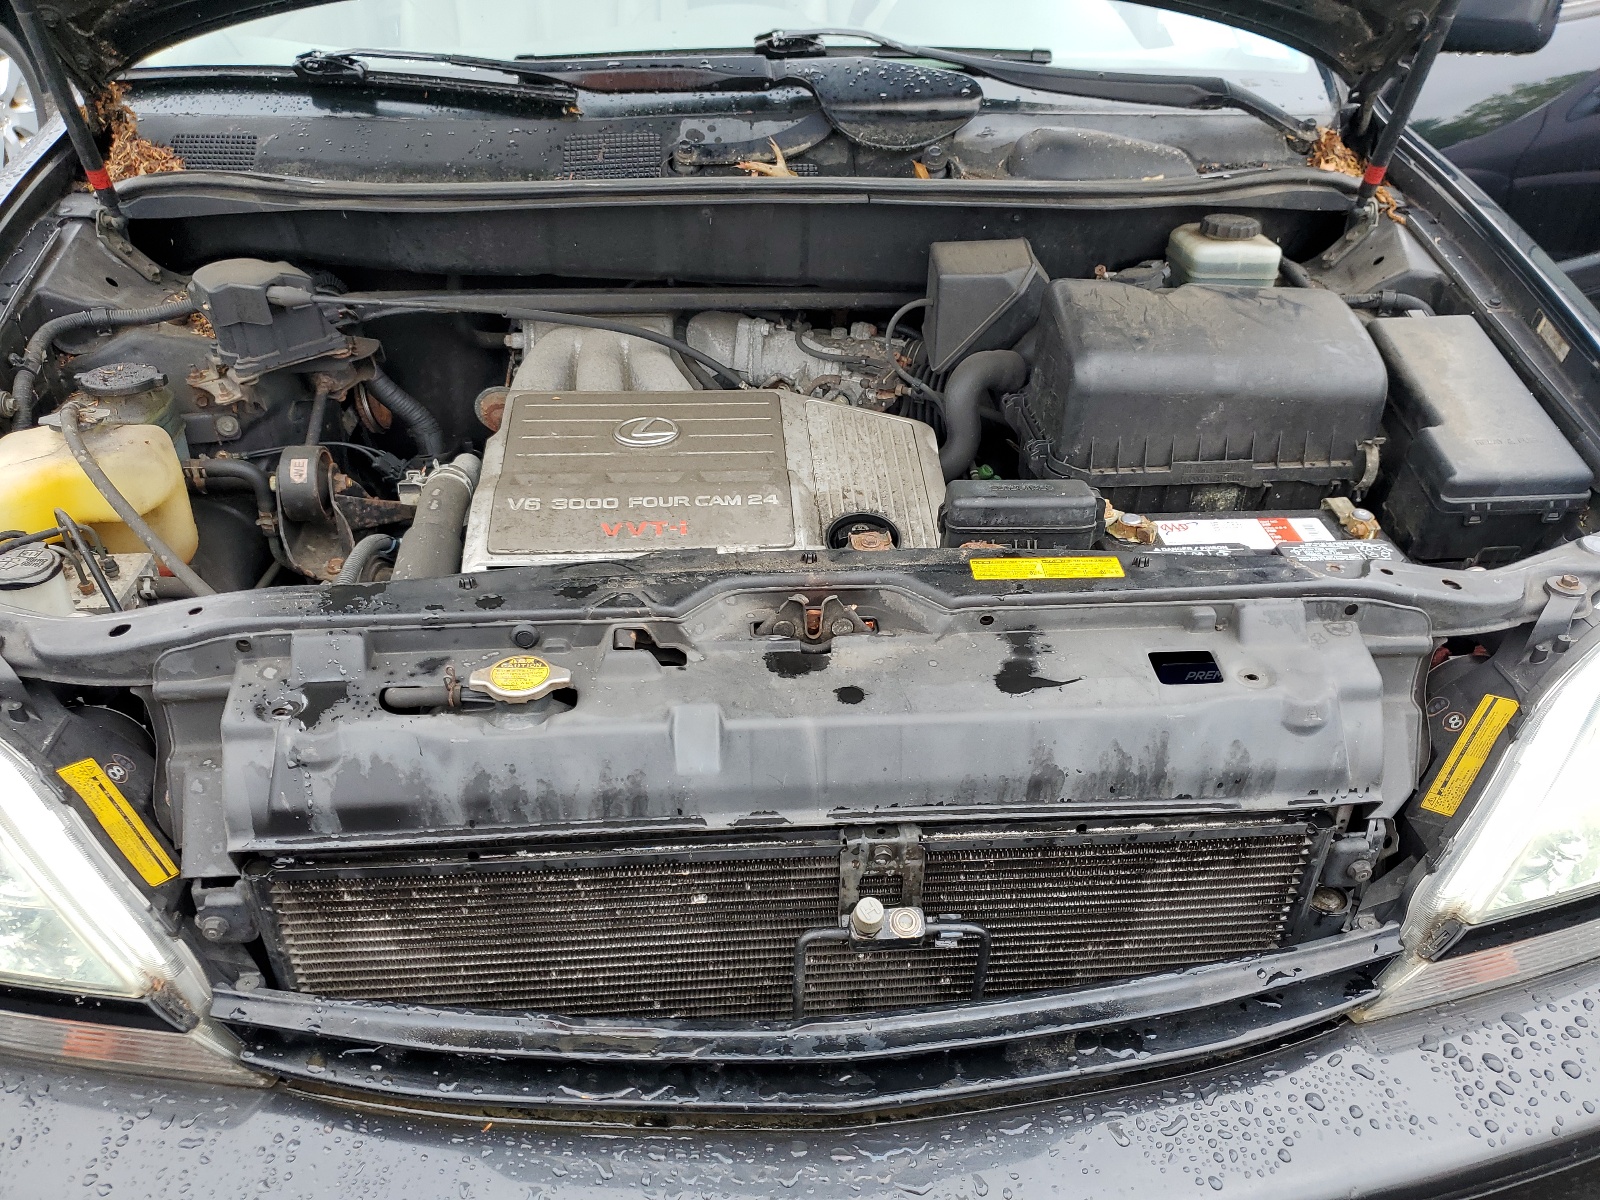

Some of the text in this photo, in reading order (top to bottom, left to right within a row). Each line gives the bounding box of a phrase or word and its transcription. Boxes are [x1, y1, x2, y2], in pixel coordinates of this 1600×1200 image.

[507, 494, 779, 511] V6 3000 FOUR CAM 24
[600, 520, 688, 537] VVT-i
